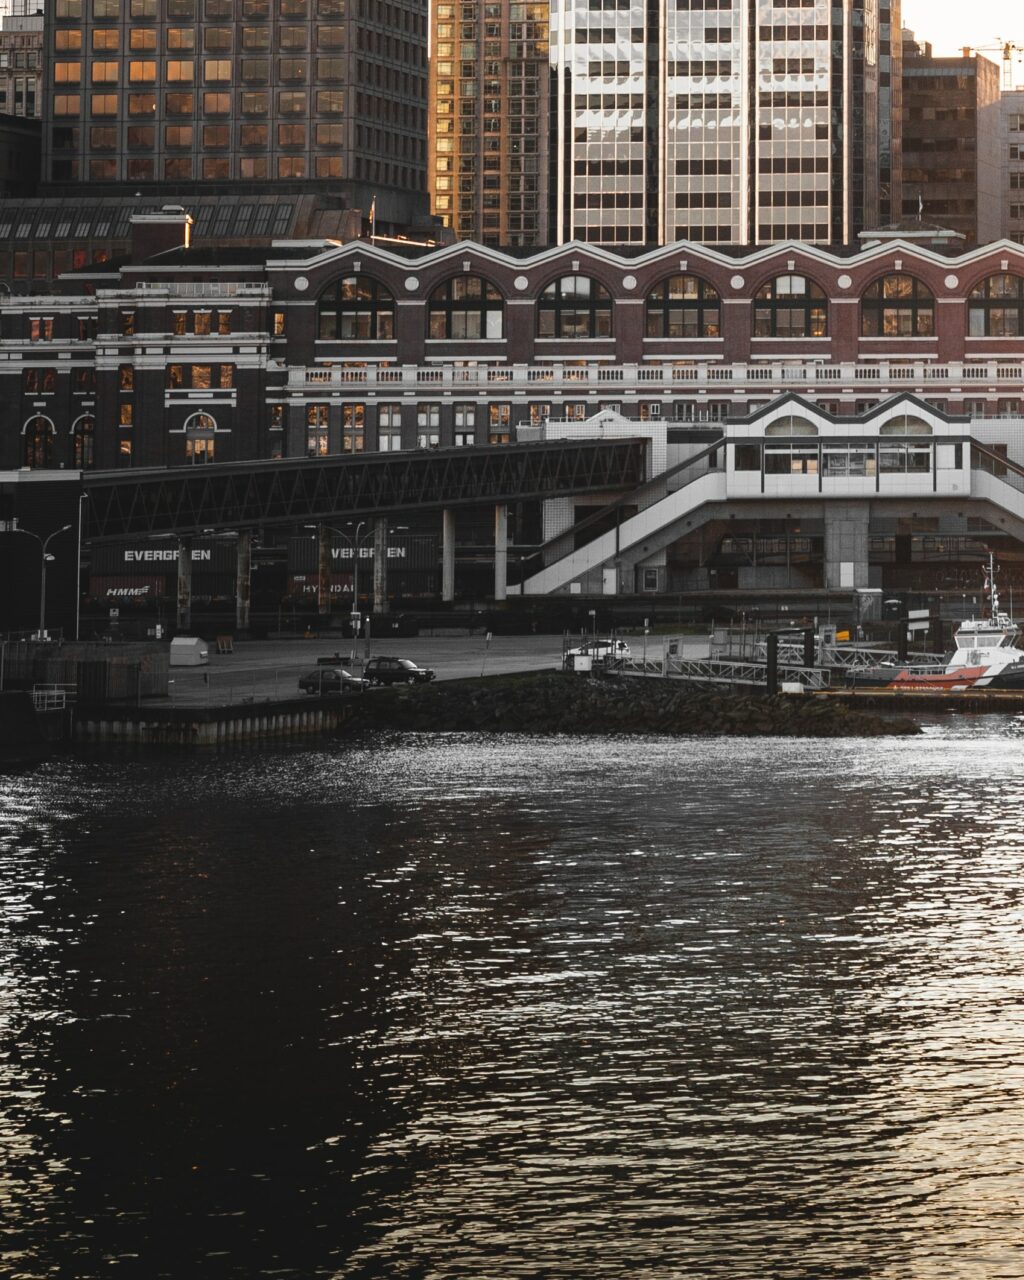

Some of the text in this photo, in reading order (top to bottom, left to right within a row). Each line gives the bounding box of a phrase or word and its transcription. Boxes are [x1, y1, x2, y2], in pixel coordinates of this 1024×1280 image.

[124, 549, 211, 561] EVERGREN
[106, 587, 140, 596] HMM
[302, 584, 354, 593] HYDAI
